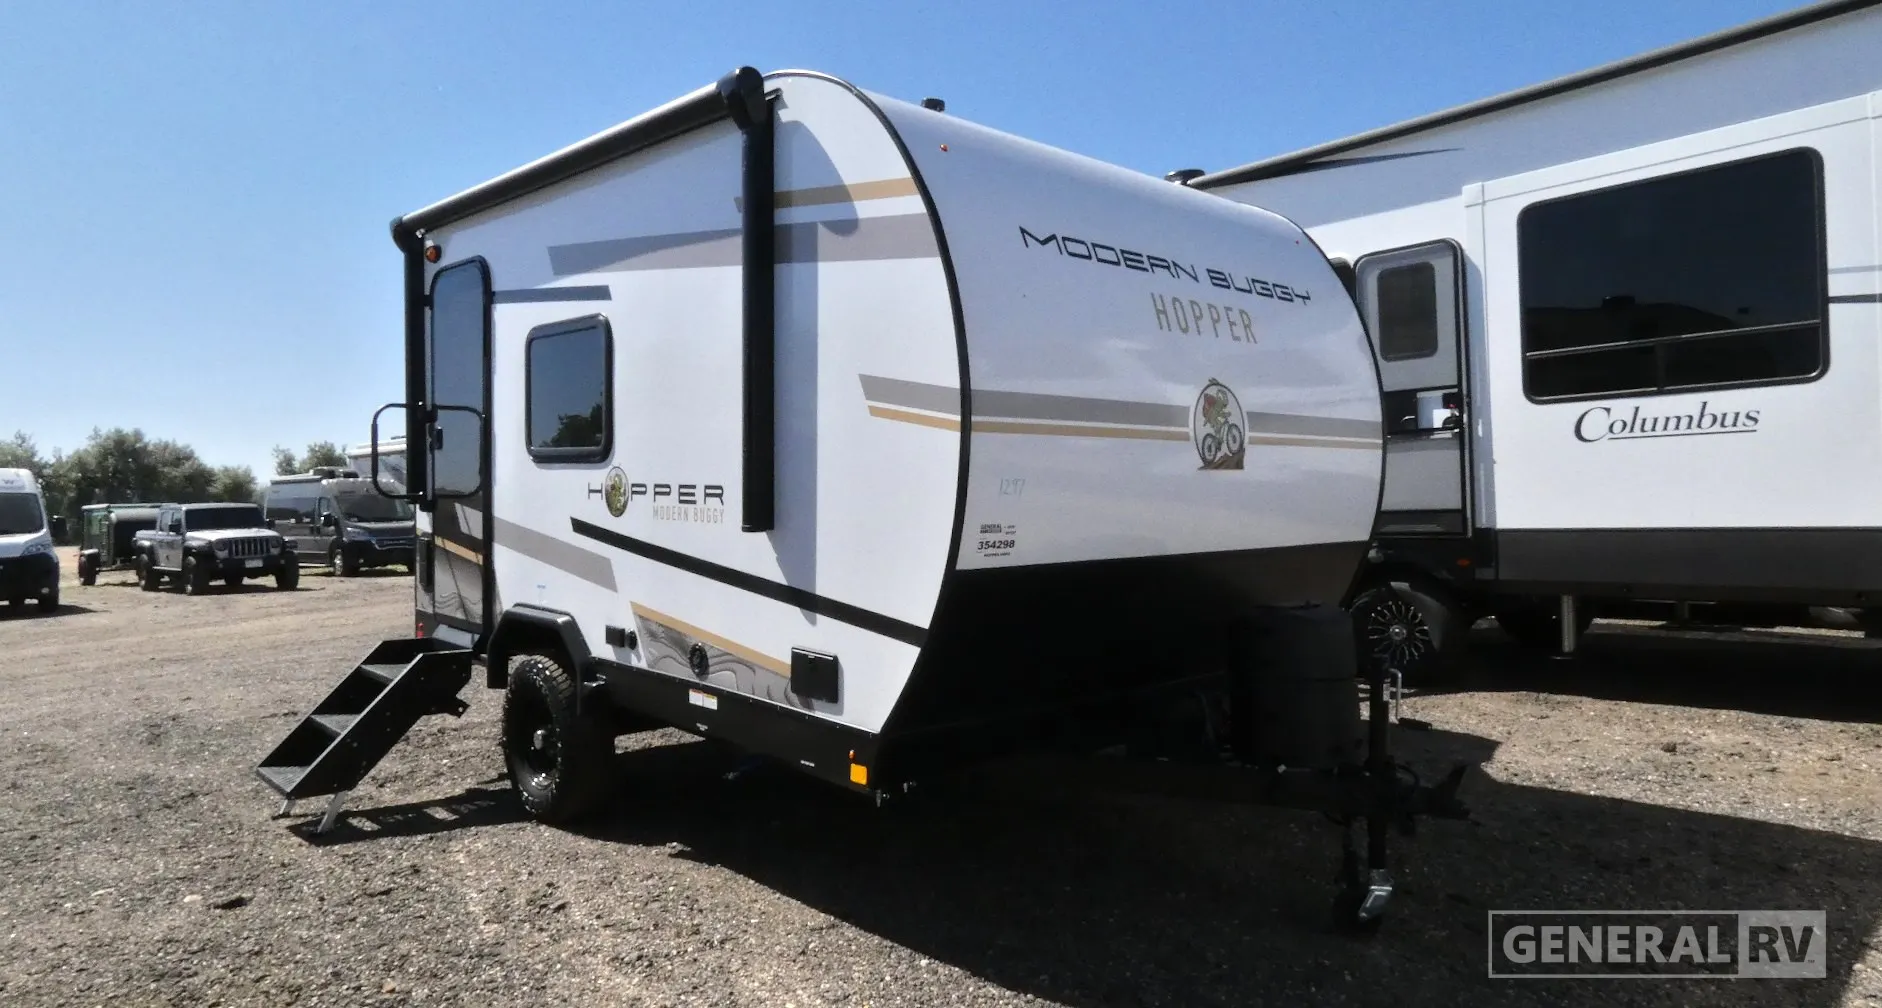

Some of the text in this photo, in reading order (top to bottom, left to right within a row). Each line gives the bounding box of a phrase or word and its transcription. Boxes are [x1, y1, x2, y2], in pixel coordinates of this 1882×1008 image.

[1018, 225, 1311, 306] MODERN BUGGY
[1150, 292, 1258, 345] HOPPER
[1573, 401, 1760, 443] Columbus
[652, 505, 725, 524] MODERN BUGGY
[977, 539, 1015, 550] 354298
